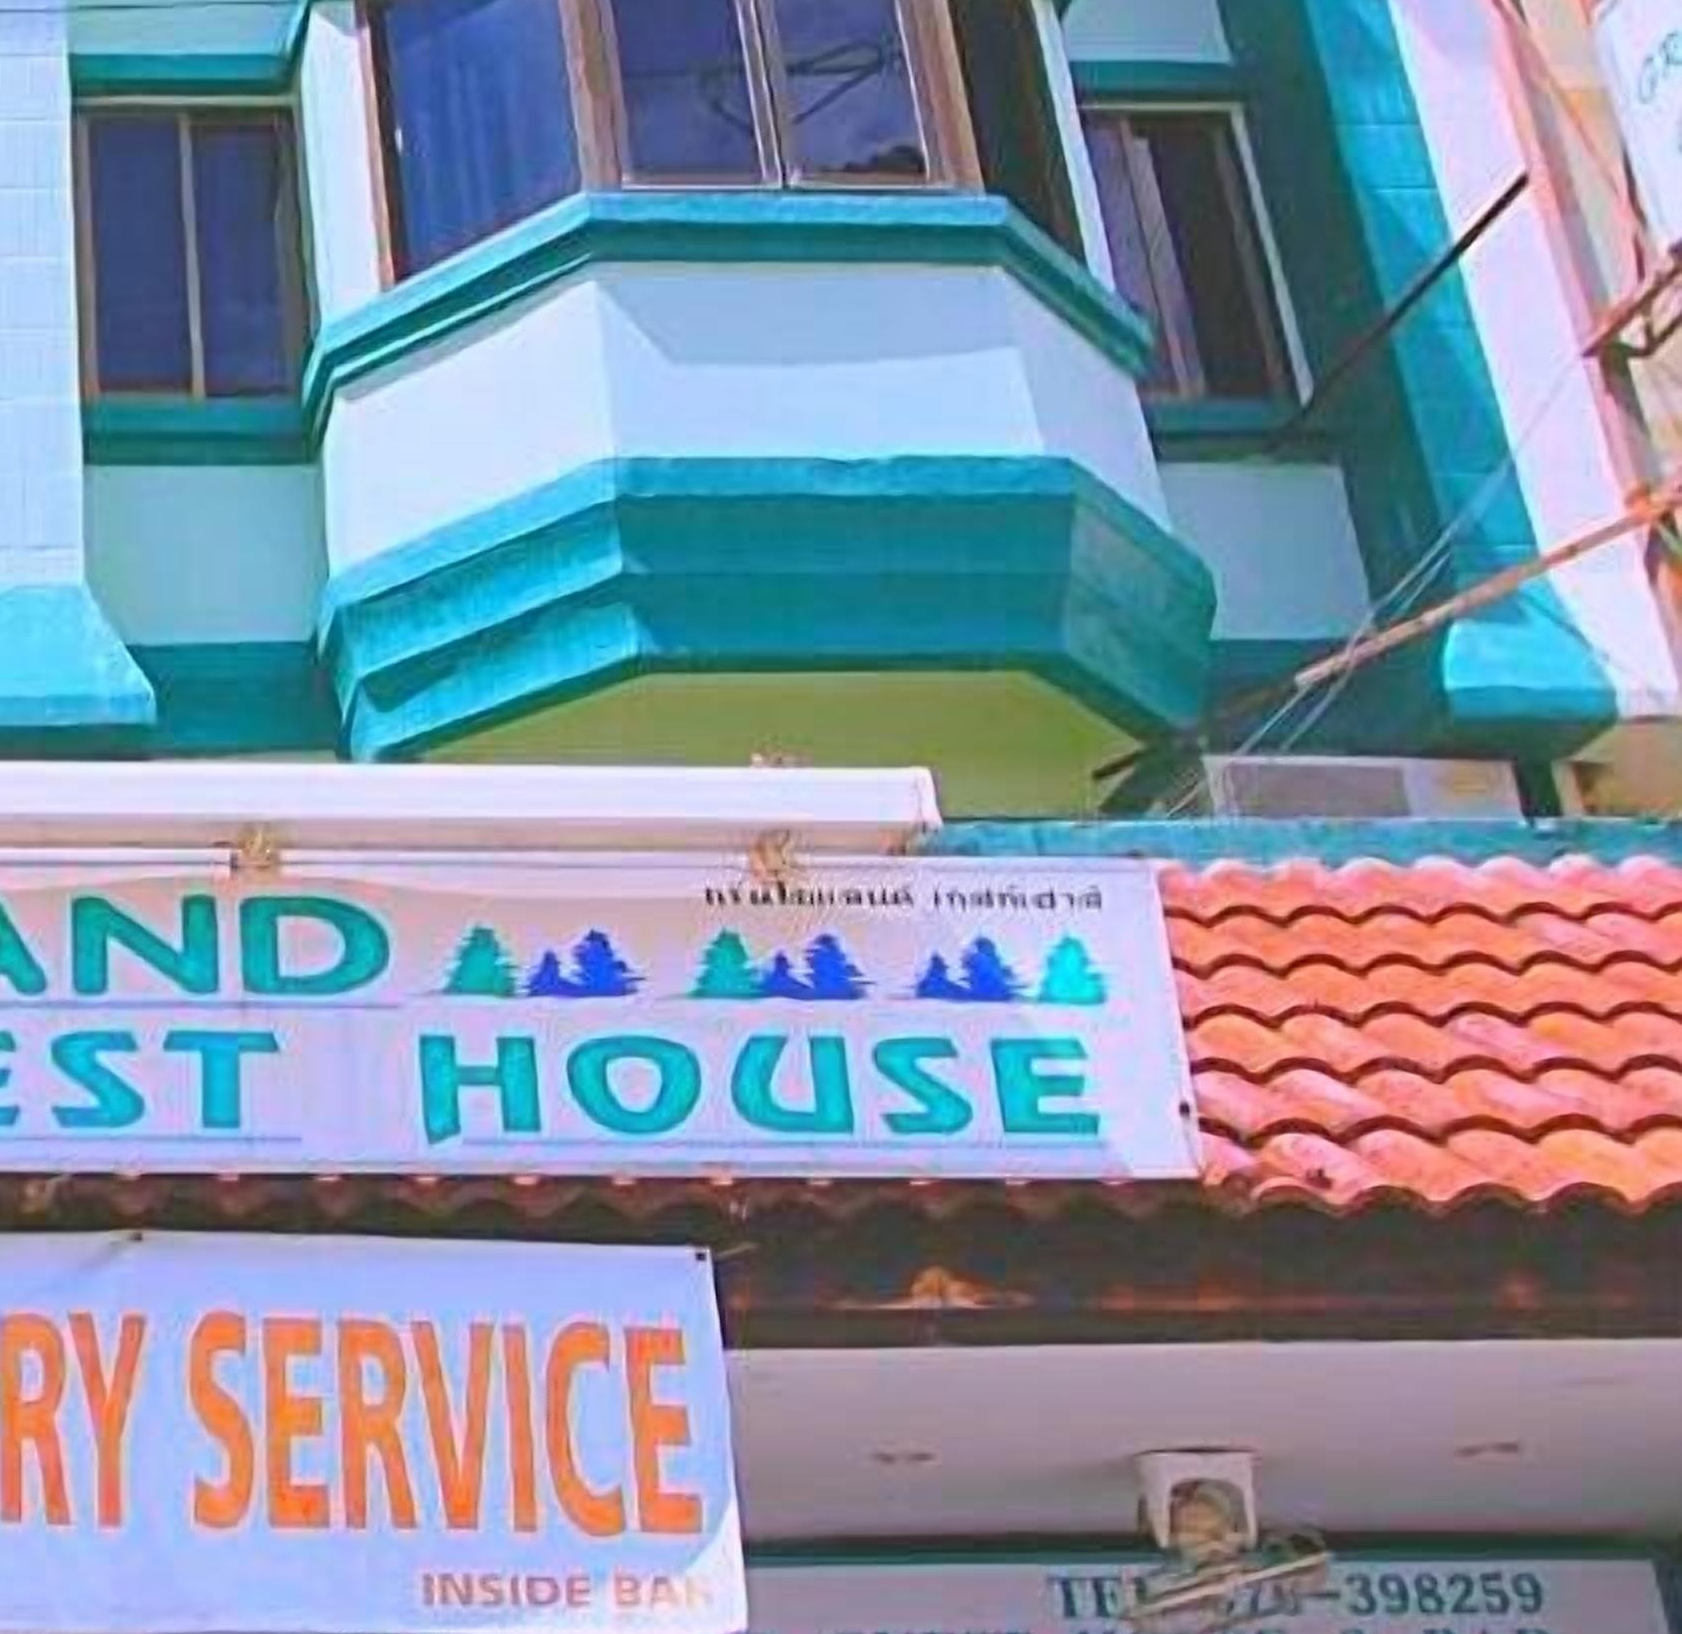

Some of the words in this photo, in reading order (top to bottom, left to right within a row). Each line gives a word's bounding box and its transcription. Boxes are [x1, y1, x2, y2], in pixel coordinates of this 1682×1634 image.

[420, 1033, 1103, 1143] HOUSE
[188, 1308, 707, 1536] SERVICE
[422, 1573, 590, 1609] INSIDE
